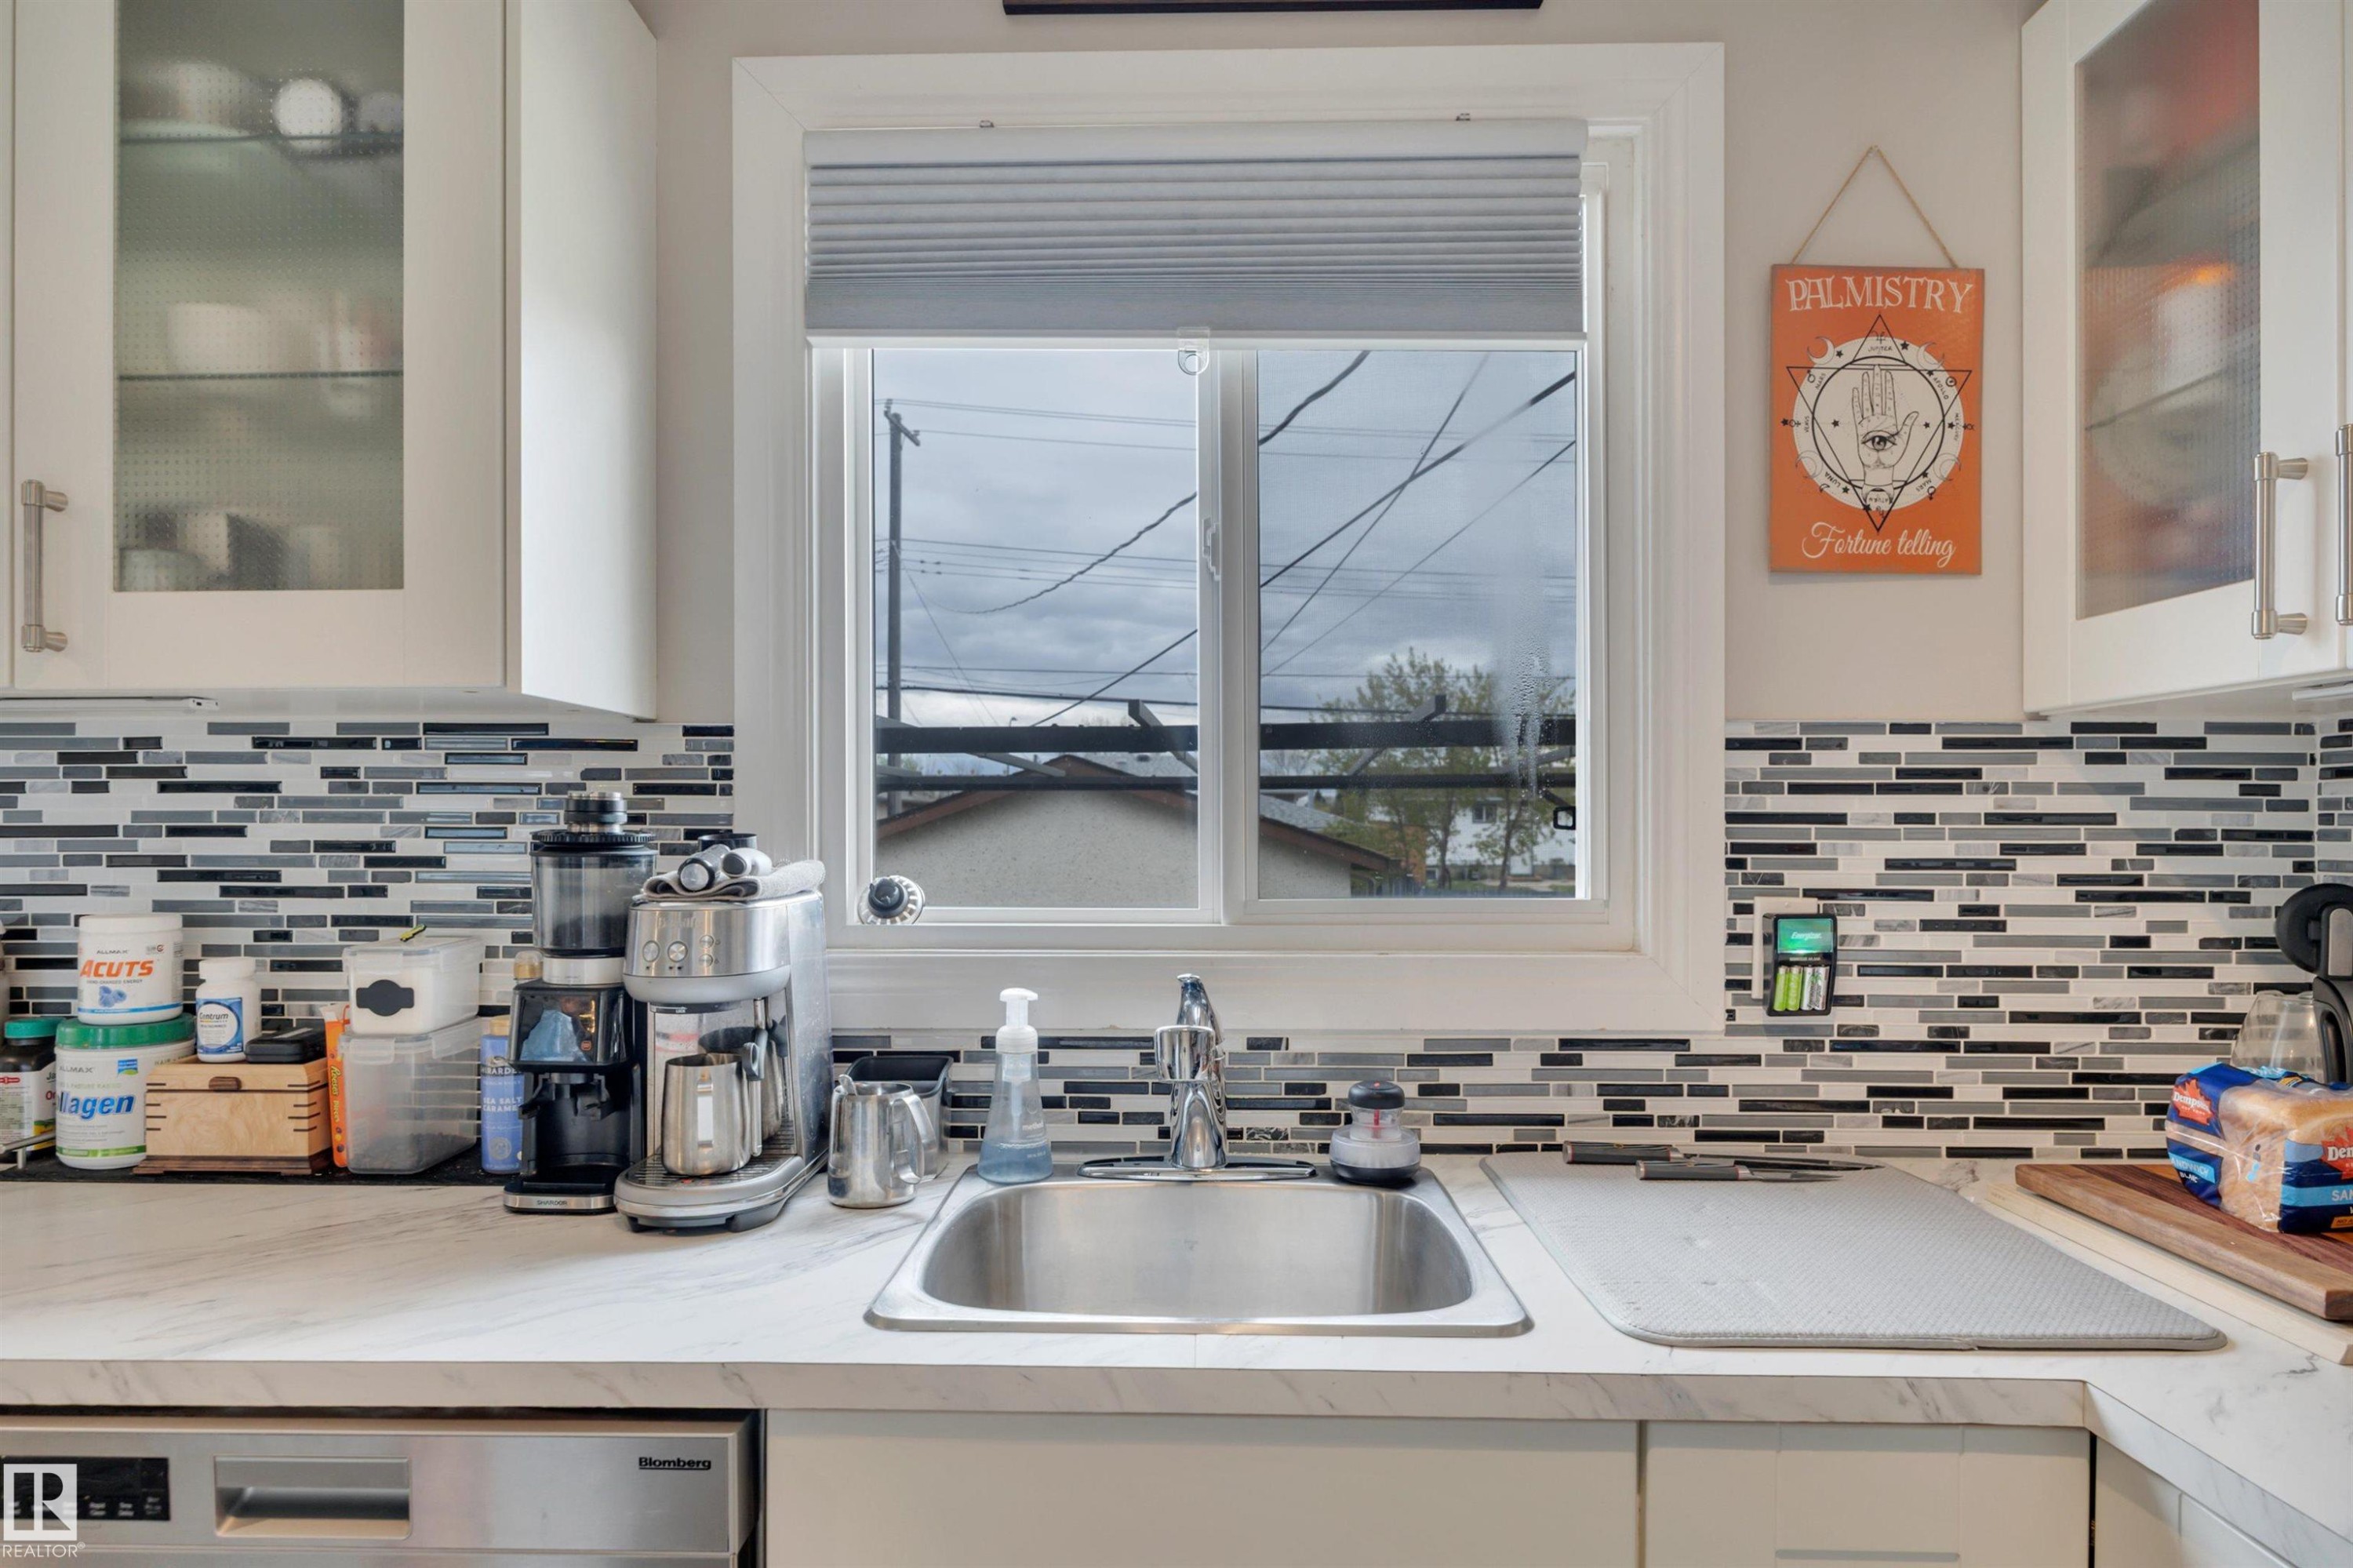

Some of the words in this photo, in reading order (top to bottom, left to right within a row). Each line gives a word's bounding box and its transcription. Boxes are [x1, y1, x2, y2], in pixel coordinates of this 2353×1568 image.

[1786, 275, 1973, 313] PALMISTRY
[1815, 373, 1827, 390] MARS
[1933, 377, 1950, 400] APOLLO
[1824, 471, 1842, 487] LUNA
[1802, 522, 1891, 558] Fortune
[1897, 529, 1956, 568] telling
[500, 1097, 522, 1105] SALT
[638, 1457, 711, 1471] Blomberg
